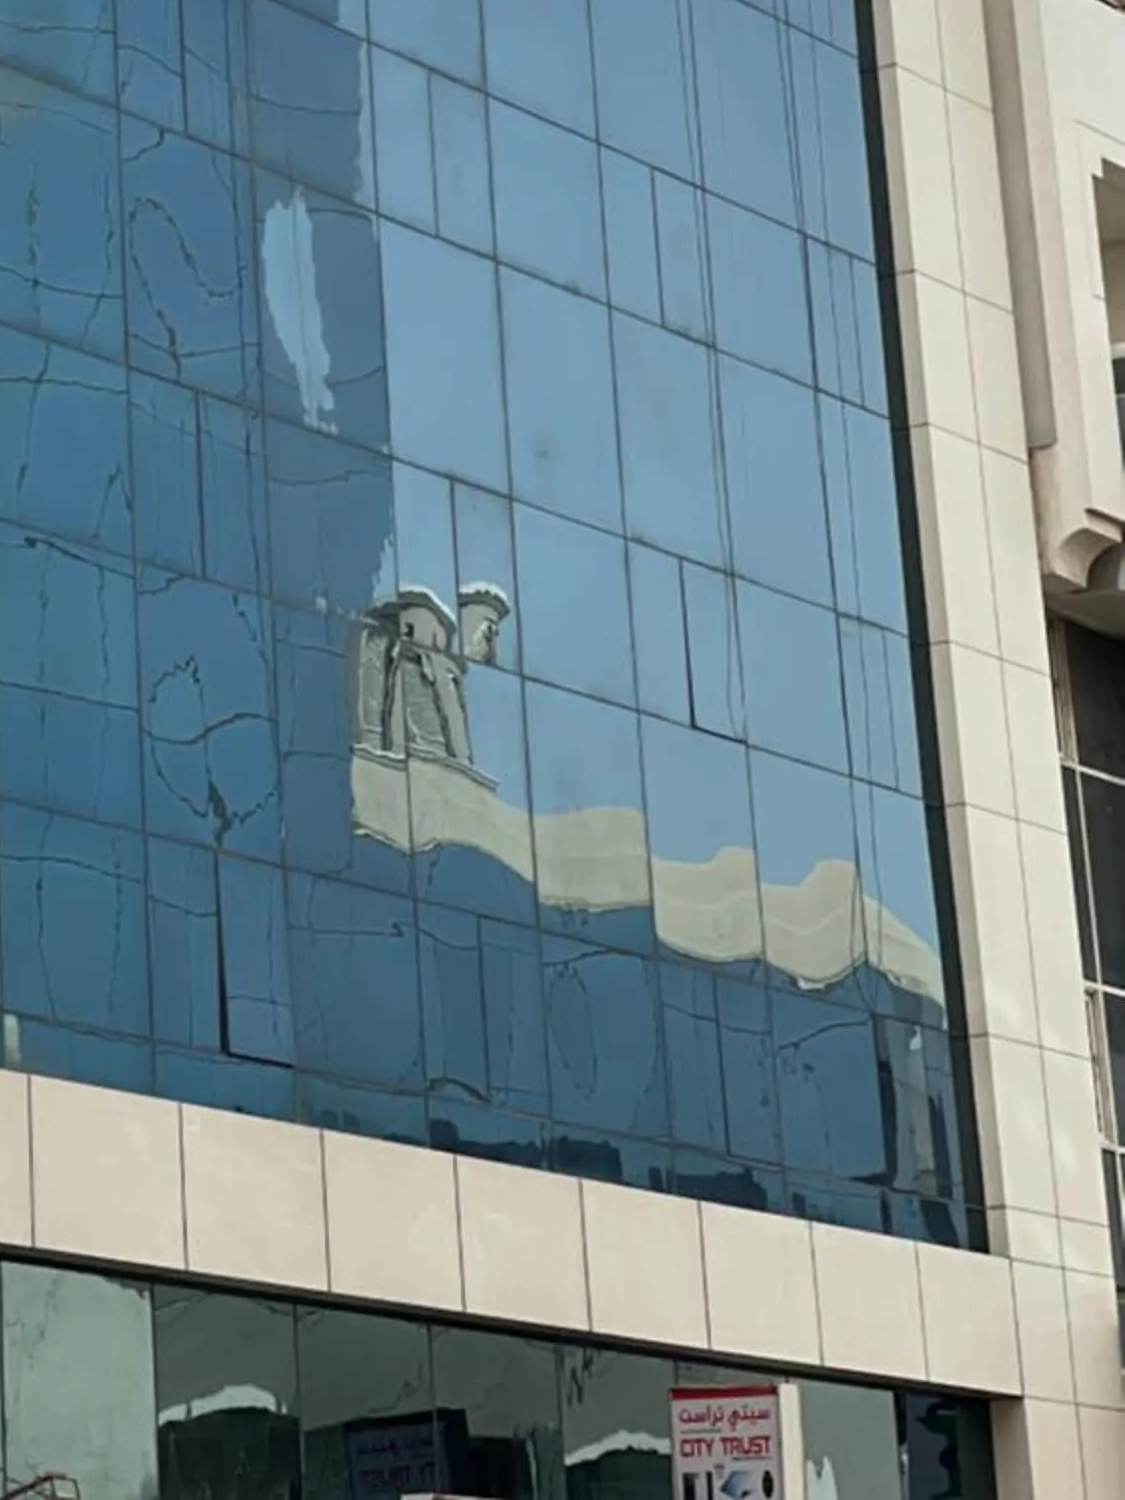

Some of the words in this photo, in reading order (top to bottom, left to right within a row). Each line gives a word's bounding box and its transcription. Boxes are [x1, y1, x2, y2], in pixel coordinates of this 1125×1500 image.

[679, 1405, 724, 1426] تراست
[728, 1403, 771, 1431] سيتي
[680, 1438, 714, 1457] CITY
[720, 1436, 771, 1456] TRUST
